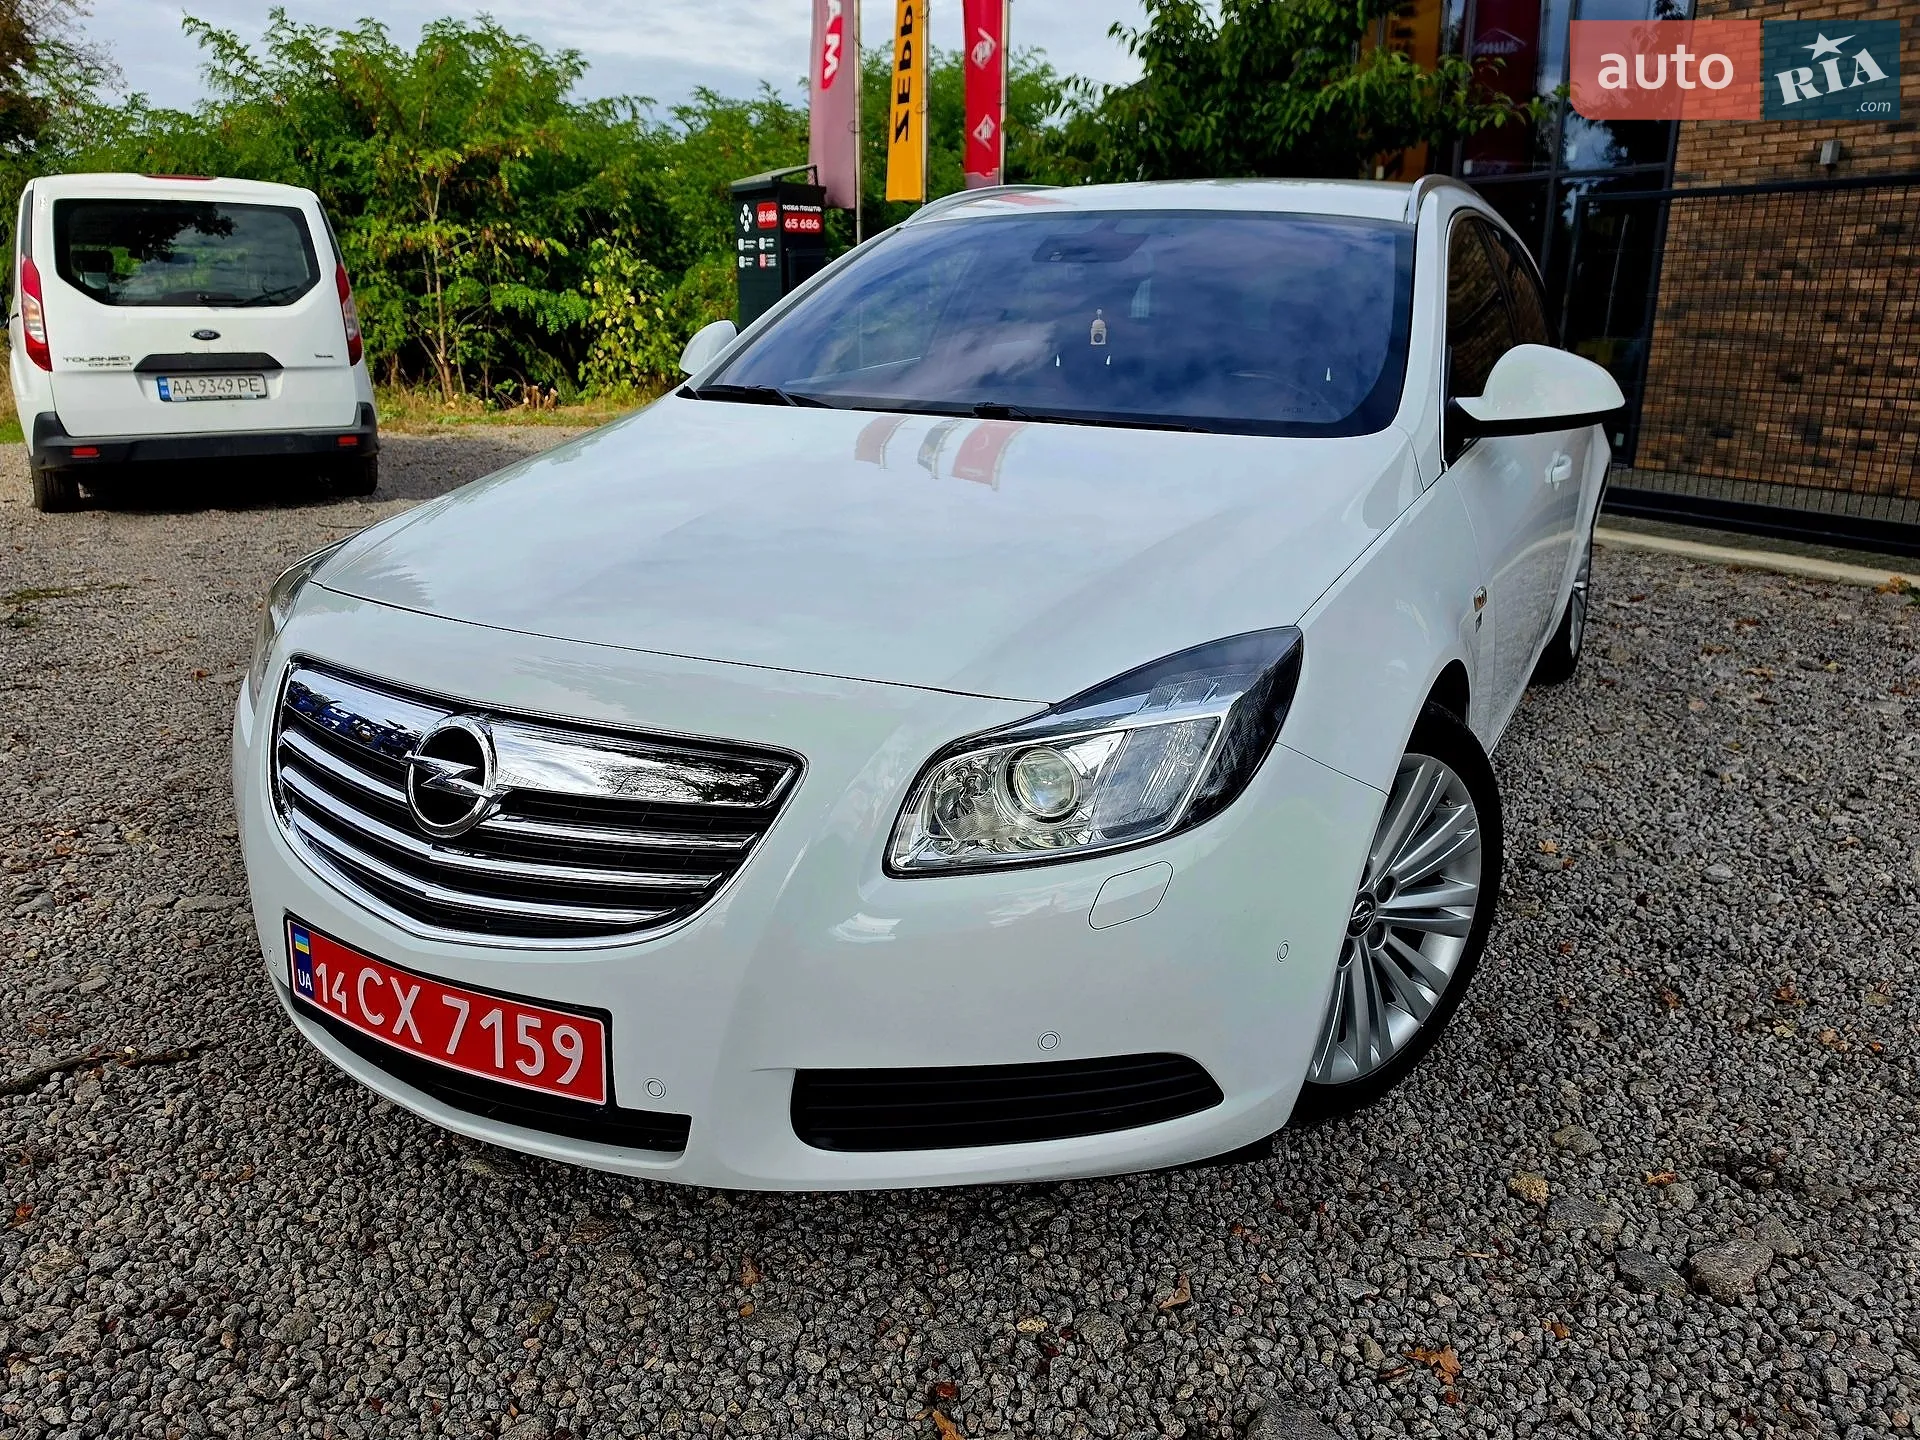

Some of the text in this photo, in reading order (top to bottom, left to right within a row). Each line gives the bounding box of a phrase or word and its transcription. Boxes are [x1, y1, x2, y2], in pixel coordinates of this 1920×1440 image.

[785, 218, 820, 230] 65 686
[172, 377, 260, 395] AA 9349 PE
[297, 968, 313, 992] UA
[315, 962, 584, 1085] 14 CX 7159
